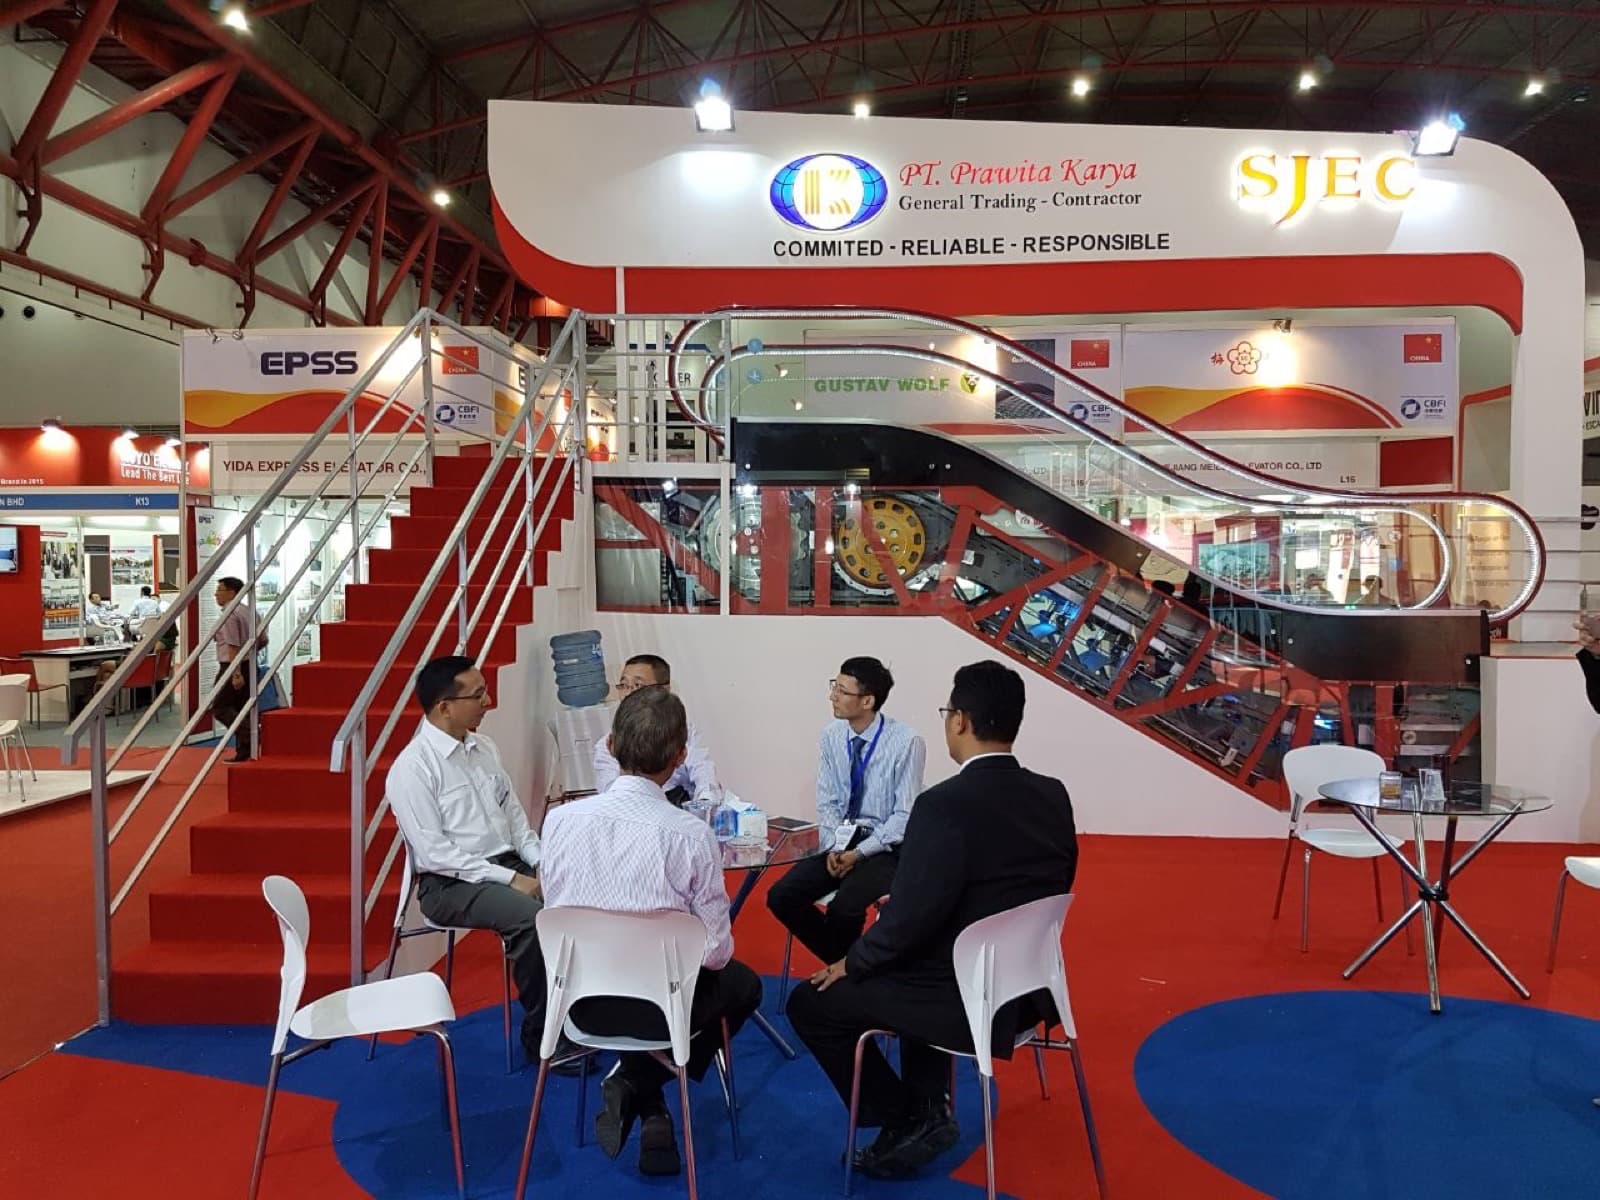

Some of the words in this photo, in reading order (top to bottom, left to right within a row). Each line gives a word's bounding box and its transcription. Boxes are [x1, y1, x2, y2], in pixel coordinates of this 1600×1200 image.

[898, 160, 941, 187] PT.
[949, 158, 1052, 186] Prawita
[1059, 156, 1138, 189] Karya
[1238, 153, 1417, 231] SJEC
[898, 194, 964, 211] General
[969, 194, 1037, 214] Trading
[1052, 191, 1142, 208] Contractor
[773, 238, 884, 257] COMMITED
[900, 236, 1005, 256] RELIABLE
[1022, 232, 1170, 253] RESPONSIBLE
[260, 350, 359, 376] EPSS
[814, 378, 890, 393] GUSTAV
[897, 377, 950, 392] WOLF
[457, 404, 480, 414] CBFI
[223, 460, 254, 473] YIDA
[258, 460, 320, 473] EXPSS
[1306, 461, 1322, 471] LTD
[142, 468, 156, 481] The
[7, 498, 25, 507] BHD
[135, 497, 149, 507] K13
